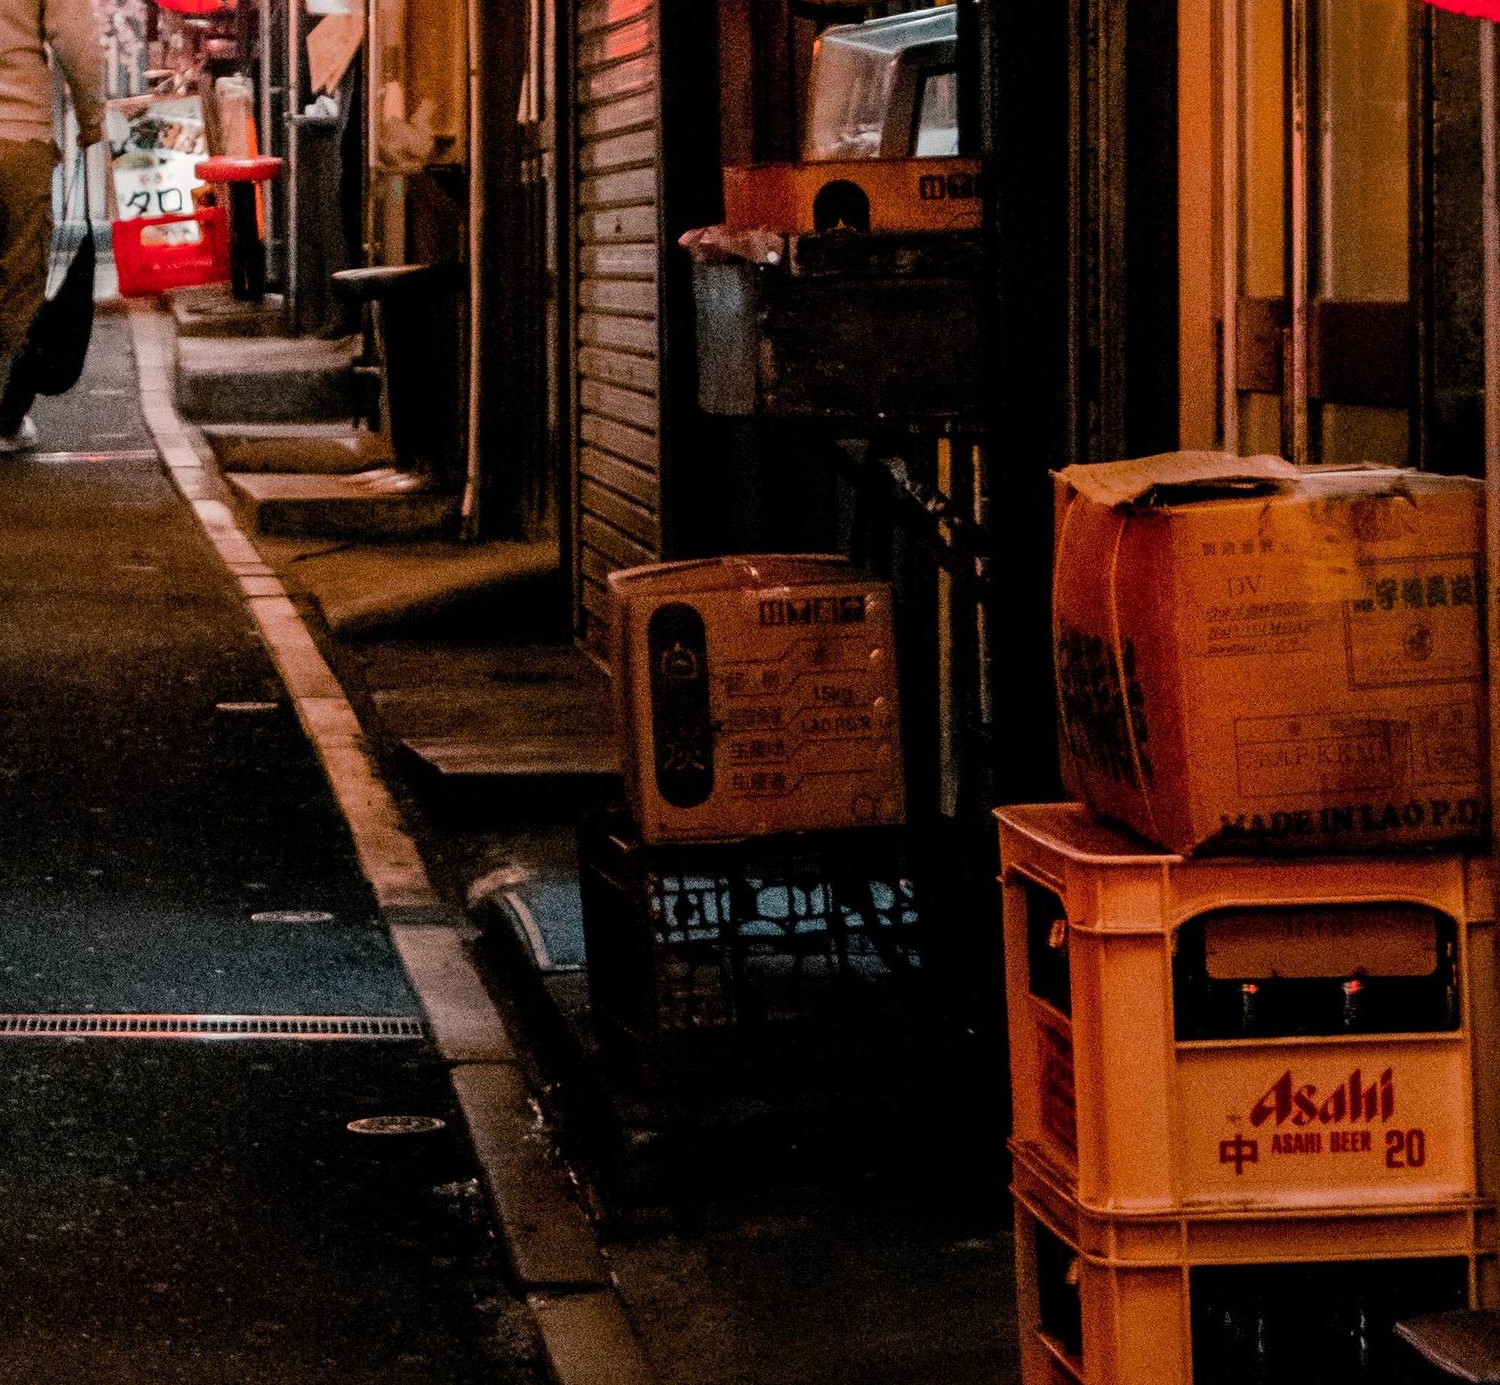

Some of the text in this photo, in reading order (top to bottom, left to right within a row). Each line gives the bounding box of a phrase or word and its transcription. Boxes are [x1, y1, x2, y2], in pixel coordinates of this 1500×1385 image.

[1322, 805, 1354, 833] IN
[1360, 802, 1424, 830] LAO
[1251, 1067, 1394, 1127] Asahi
[1219, 1128, 1426, 1176] 中 ASAHI BEER 20
